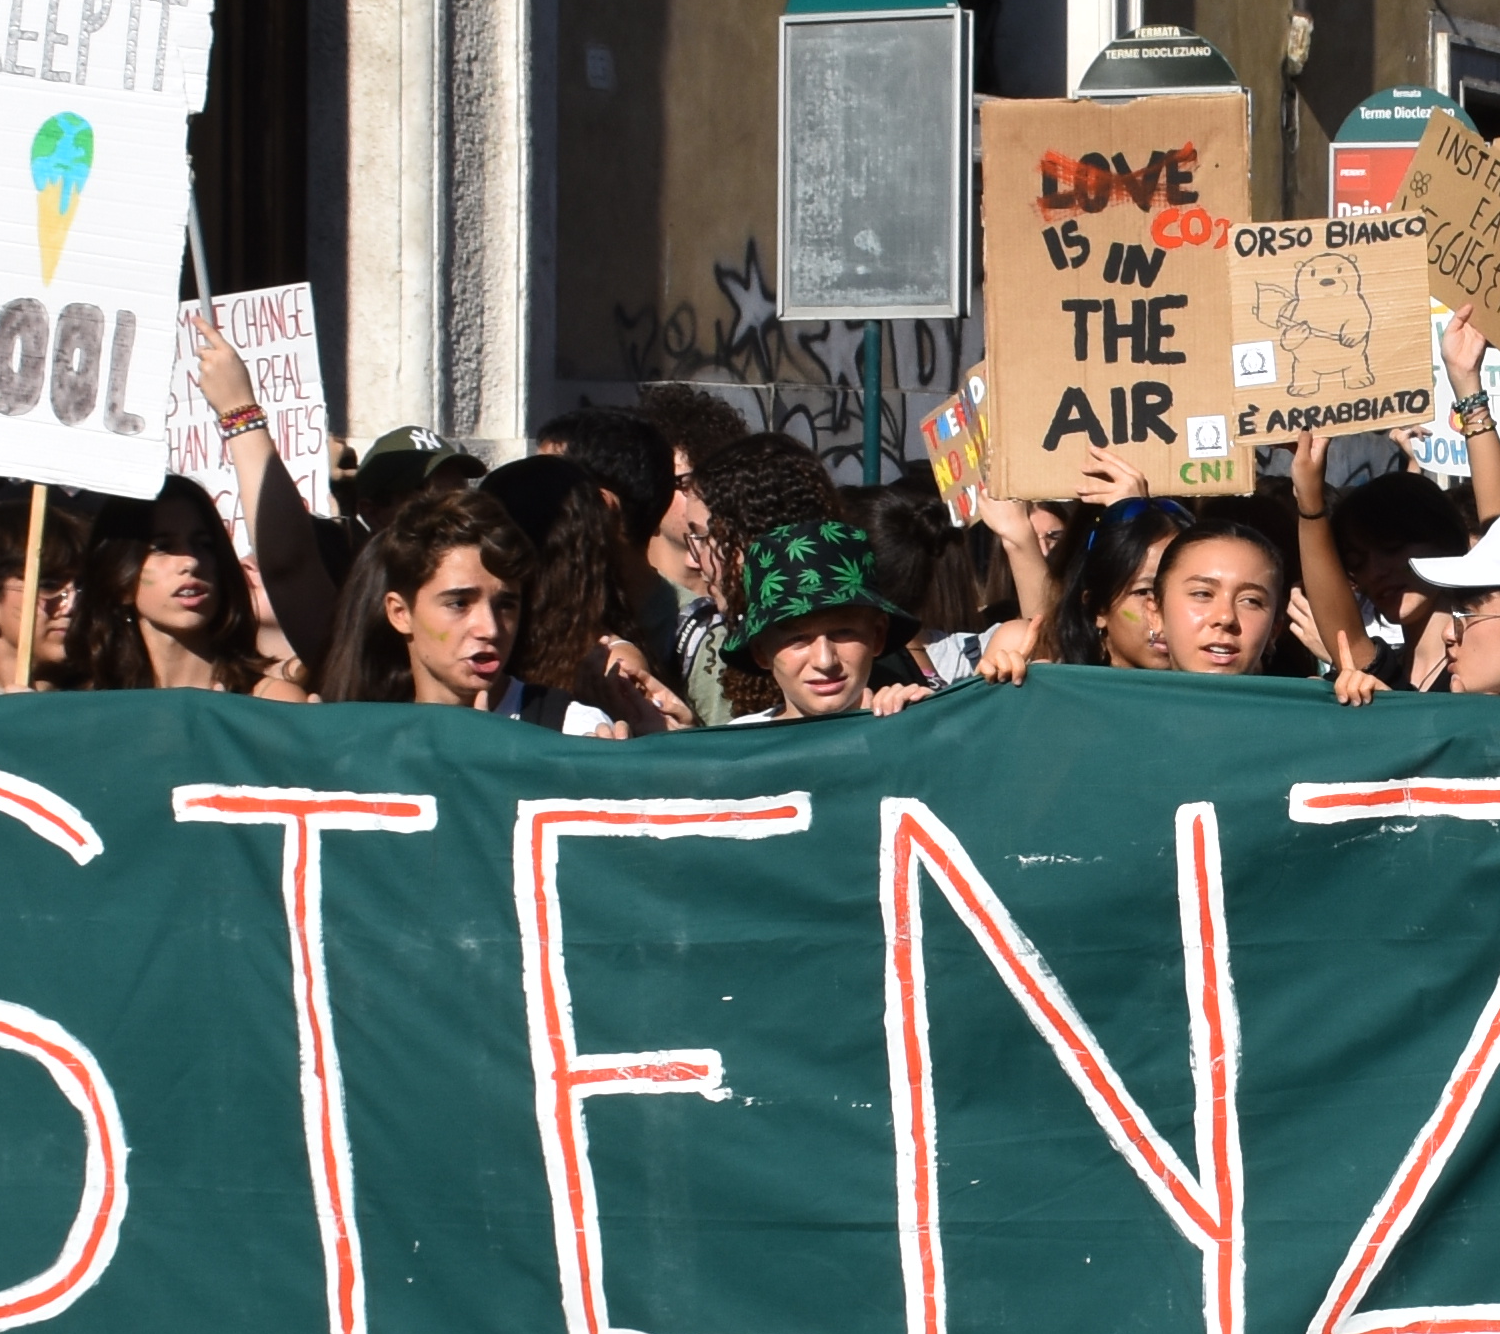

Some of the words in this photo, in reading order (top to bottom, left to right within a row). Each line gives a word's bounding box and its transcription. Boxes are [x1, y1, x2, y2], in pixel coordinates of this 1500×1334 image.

[1105, 48, 1140, 60] TERME
[1142, 46, 1211, 59] DIOCLEZIANO
[1135, 26, 1180, 38] FERMATA
[1359, 107, 1392, 119] Terme
[1393, 89, 1421, 98] fermata
[1040, 147, 1200, 213] LOVE
[1042, 219, 1091, 270] IS
[1234, 225, 1313, 258] ORSO
[1325, 215, 1427, 249] BIANCO
[1103, 242, 1167, 288] IN
[231, 285, 313, 350] CHANGE
[1062, 294, 1189, 365] THE
[257, 351, 311, 405] REAL
[1042, 381, 1178, 452] AIR
[1237, 403, 1260, 436] È
[1266, 388, 1430, 434] ARRABBIATO
[166, 424, 209, 474] HAN
[1414, 437, 1467, 465] JOH
